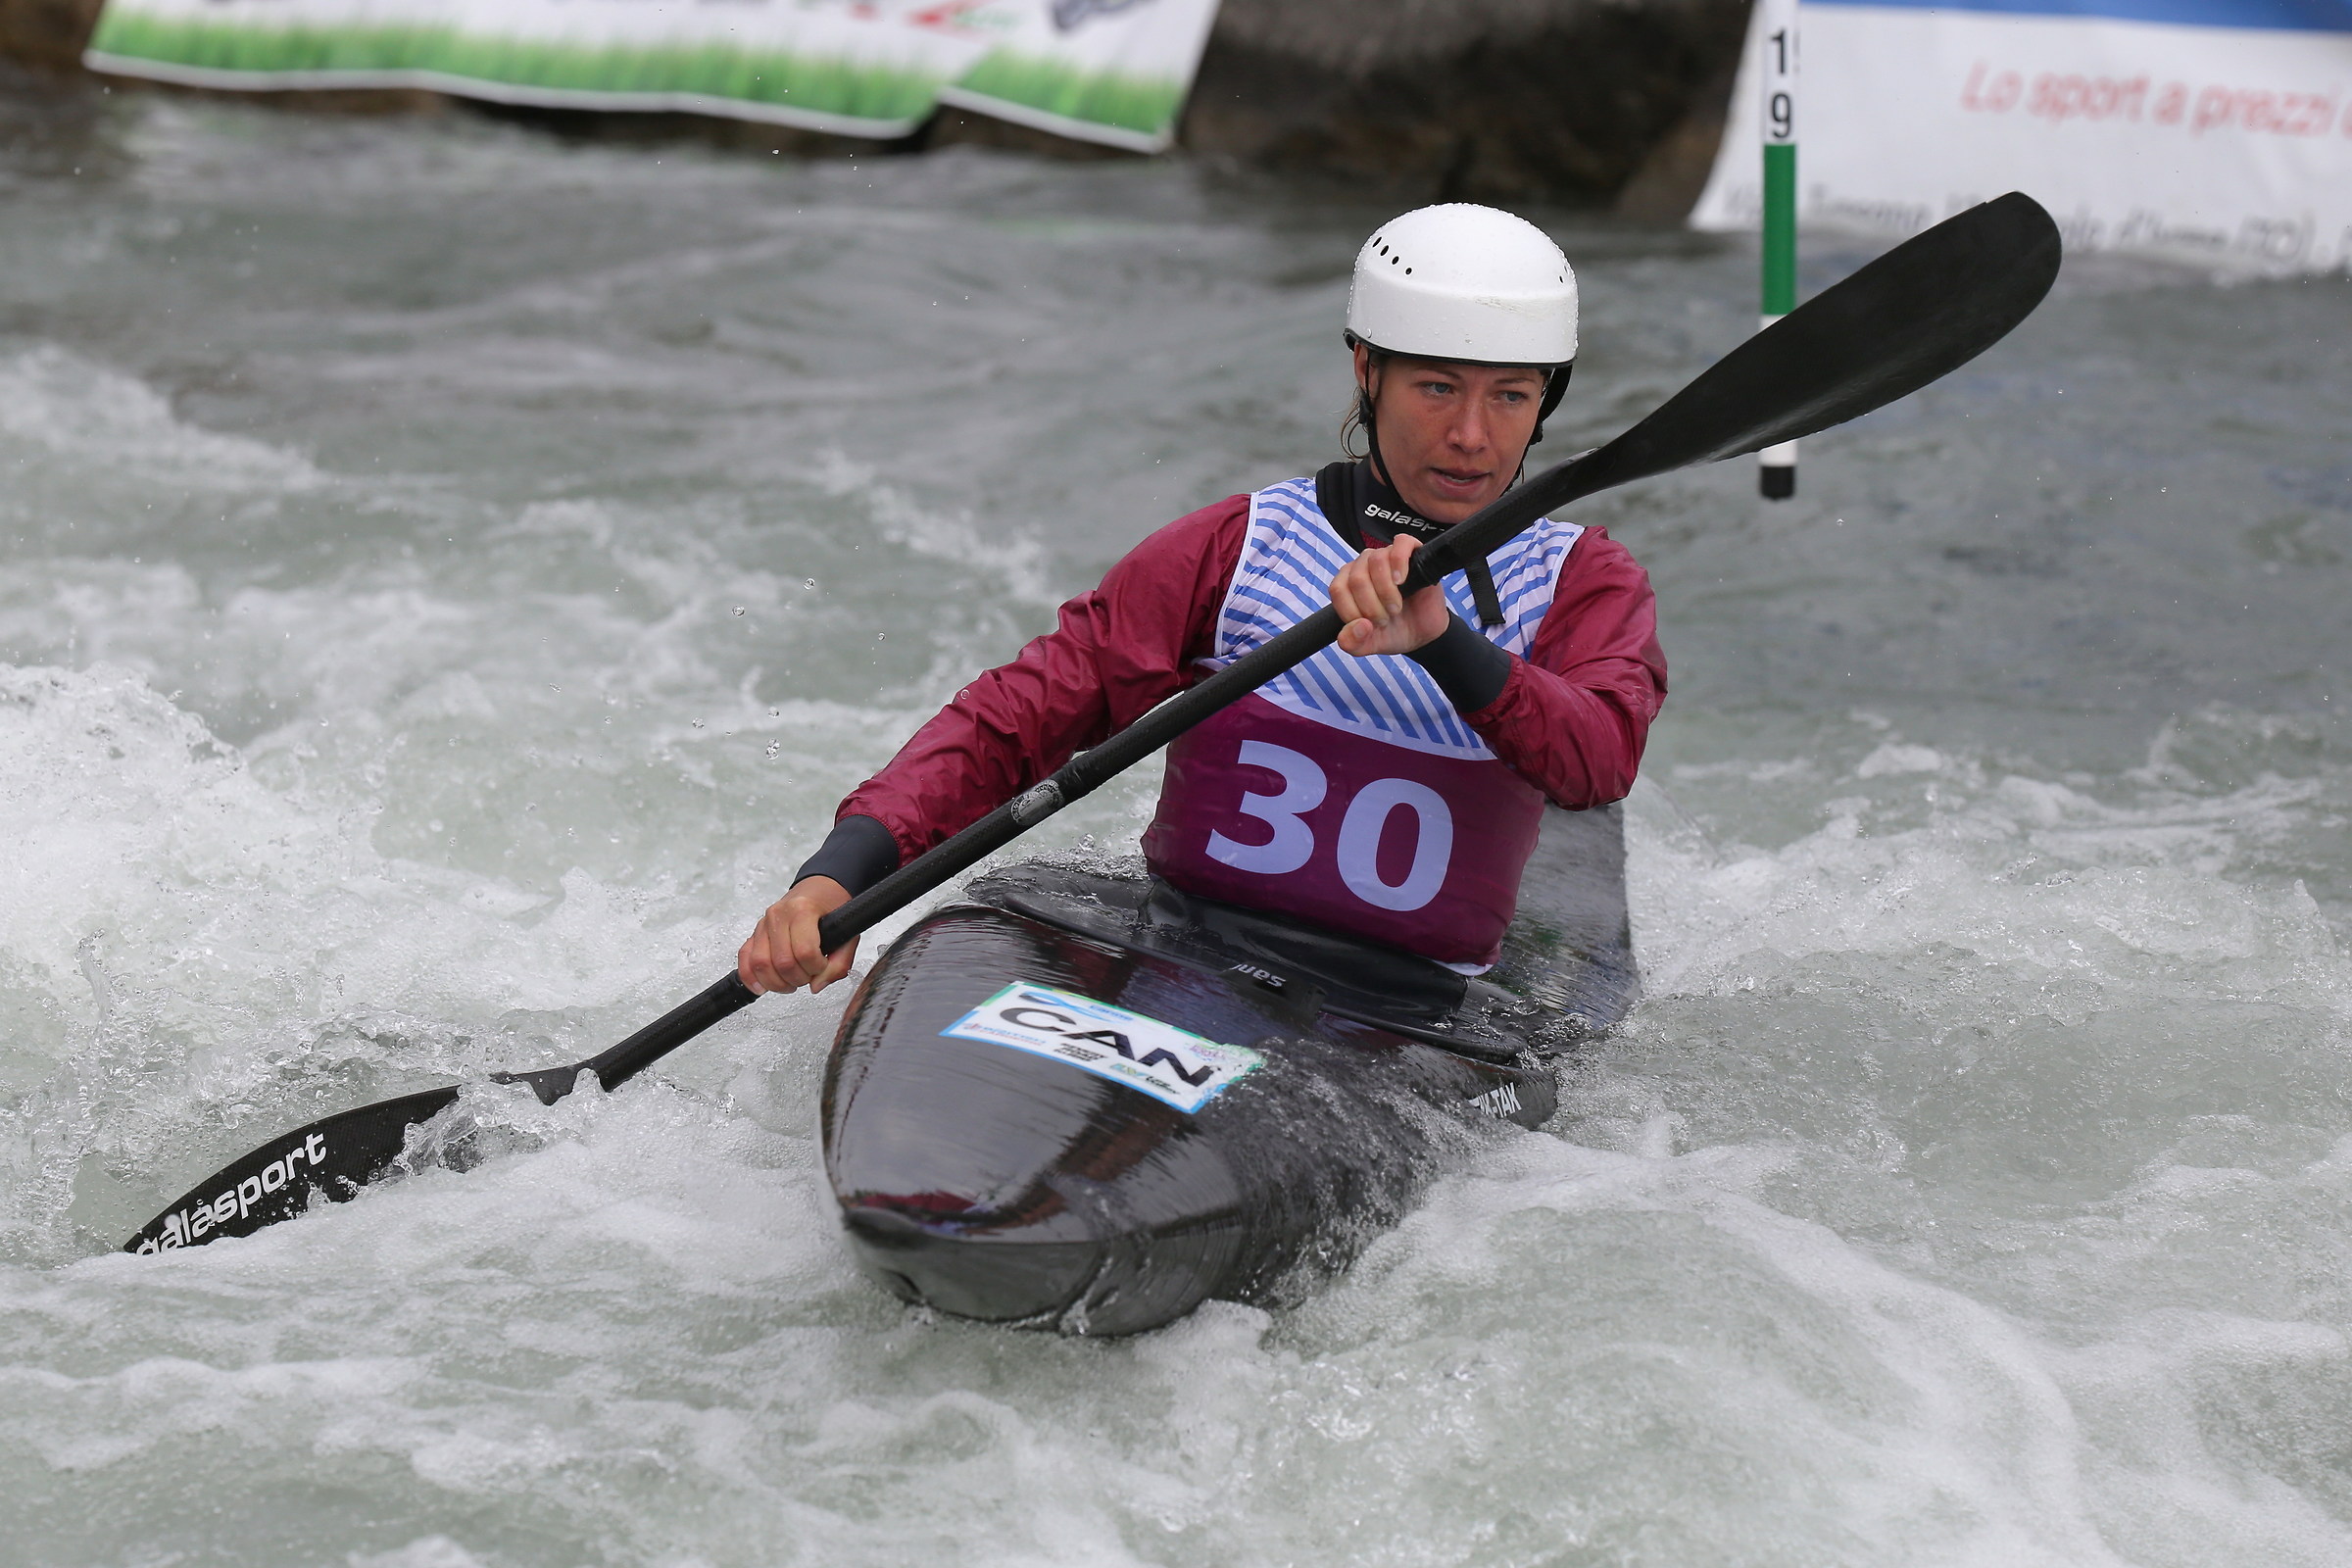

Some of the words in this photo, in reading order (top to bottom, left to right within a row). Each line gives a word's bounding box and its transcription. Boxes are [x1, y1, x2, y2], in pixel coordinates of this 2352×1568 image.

[1961, 61, 2023, 113] Lo
[2027, 70, 2150, 126] sport
[2153, 81, 2188, 125] a
[2189, 80, 2341, 140] prezzi
[1205, 739, 1453, 911] 30
[1000, 1007, 1216, 1088] CAN
